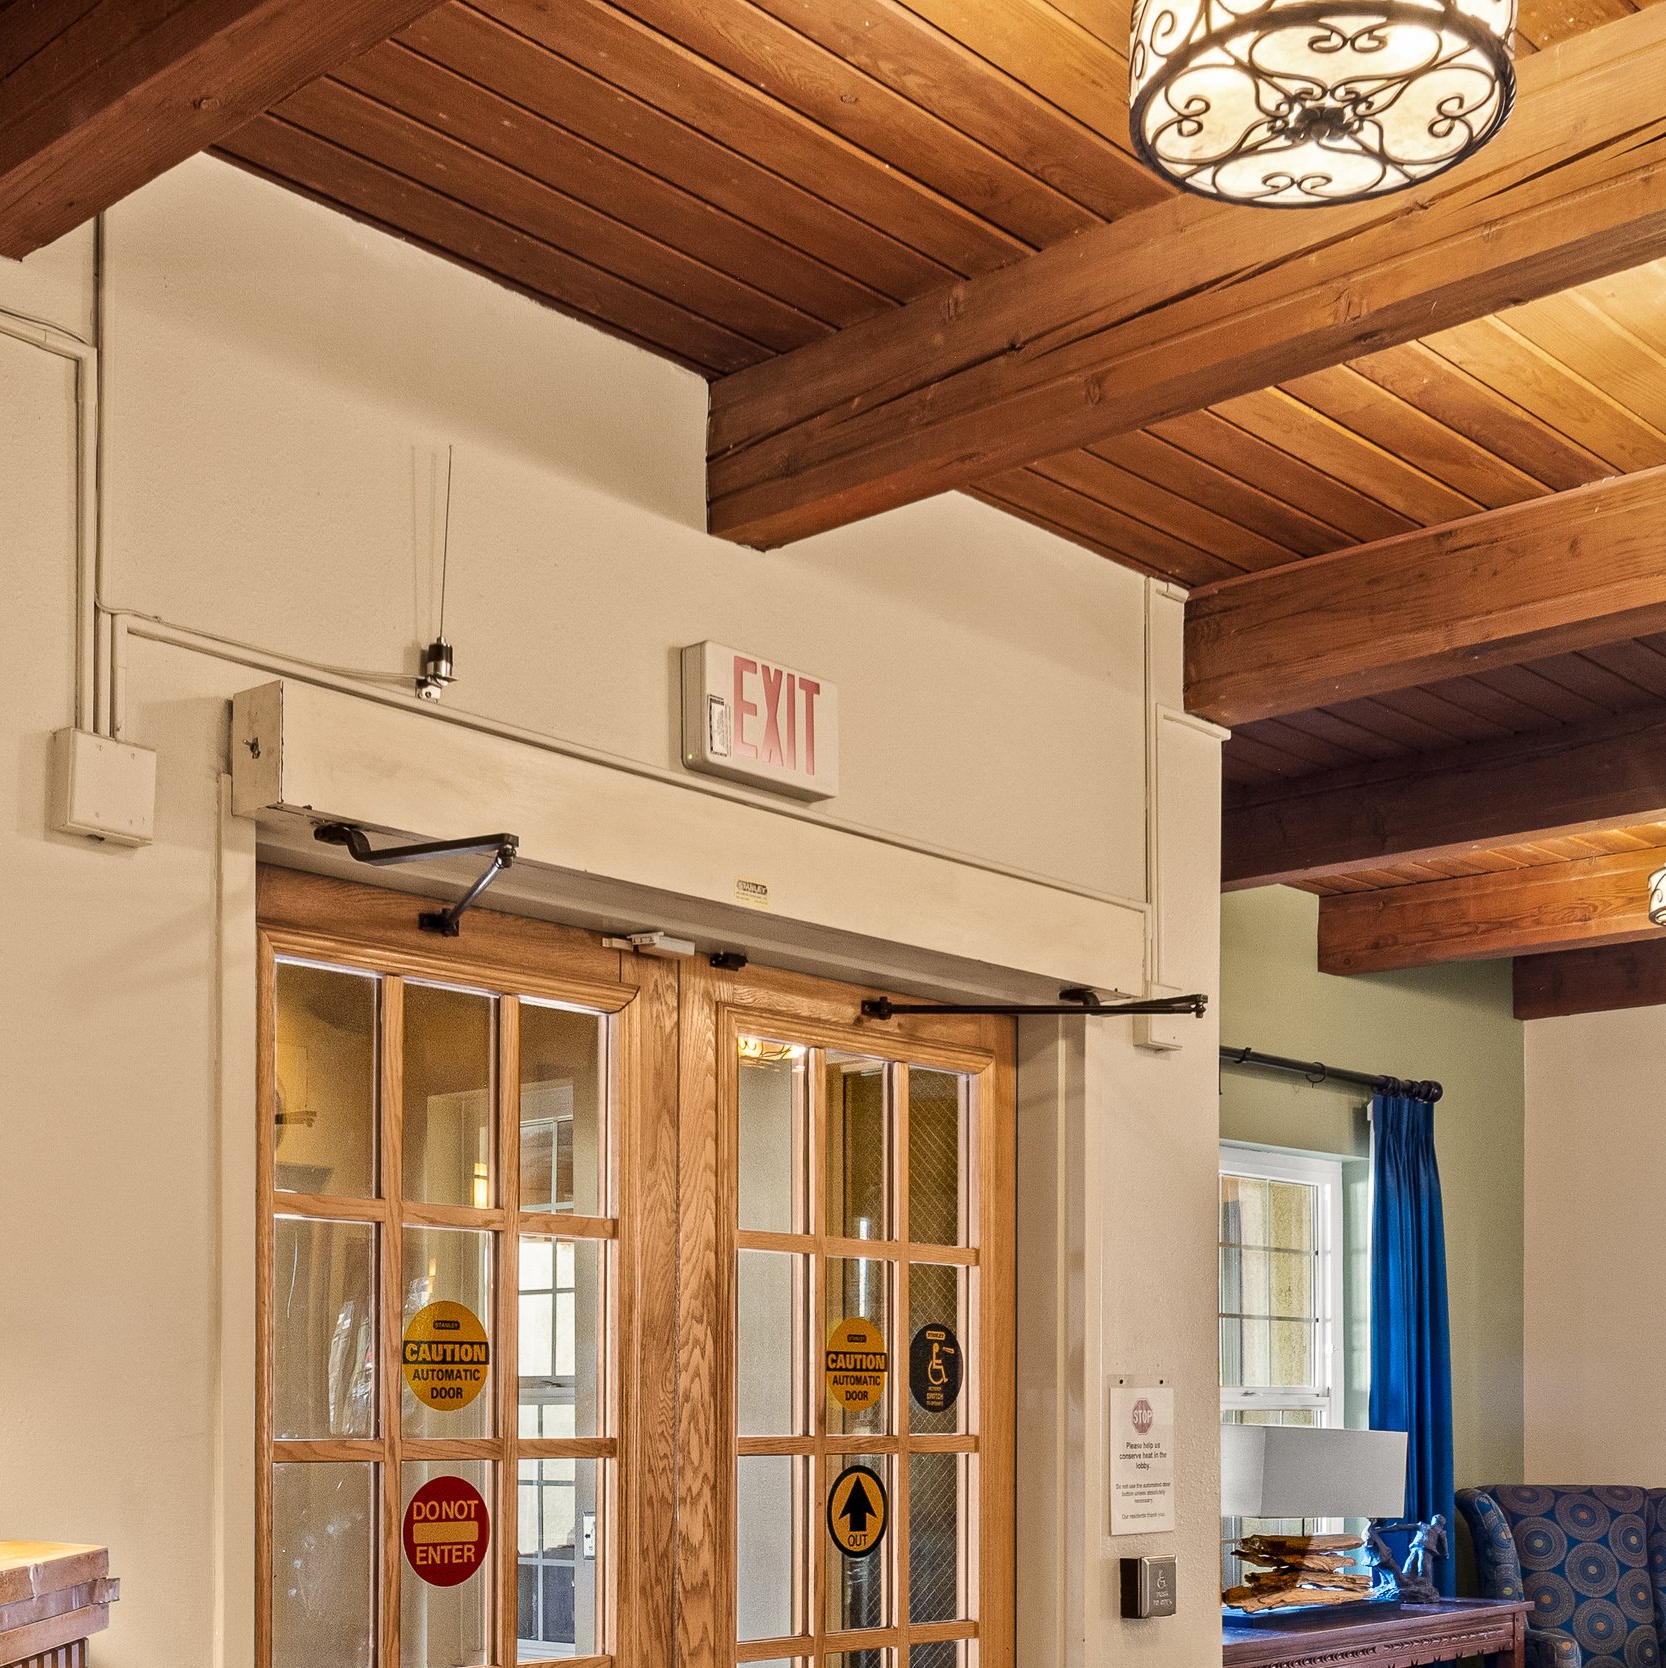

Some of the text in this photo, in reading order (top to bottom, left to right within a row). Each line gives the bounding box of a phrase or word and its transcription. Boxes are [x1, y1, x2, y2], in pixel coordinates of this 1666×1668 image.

[733, 655, 820, 776] EXIT
[405, 1343, 486, 1362] CAUTION
[827, 1354, 885, 1369] CAUTION
[412, 1369, 480, 1381] AUTOMATIC
[833, 1375, 881, 1386] AUTOMATIC
[431, 1387, 463, 1399] DOOR
[845, 1390, 868, 1401] DOOR
[1133, 1410, 1152, 1424] STOP
[1143, 1441, 1153, 1449] help
[413, 1500, 479, 1520] DO NOT
[847, 1534, 868, 1547] OUT
[416, 1545, 475, 1565] ENTER
